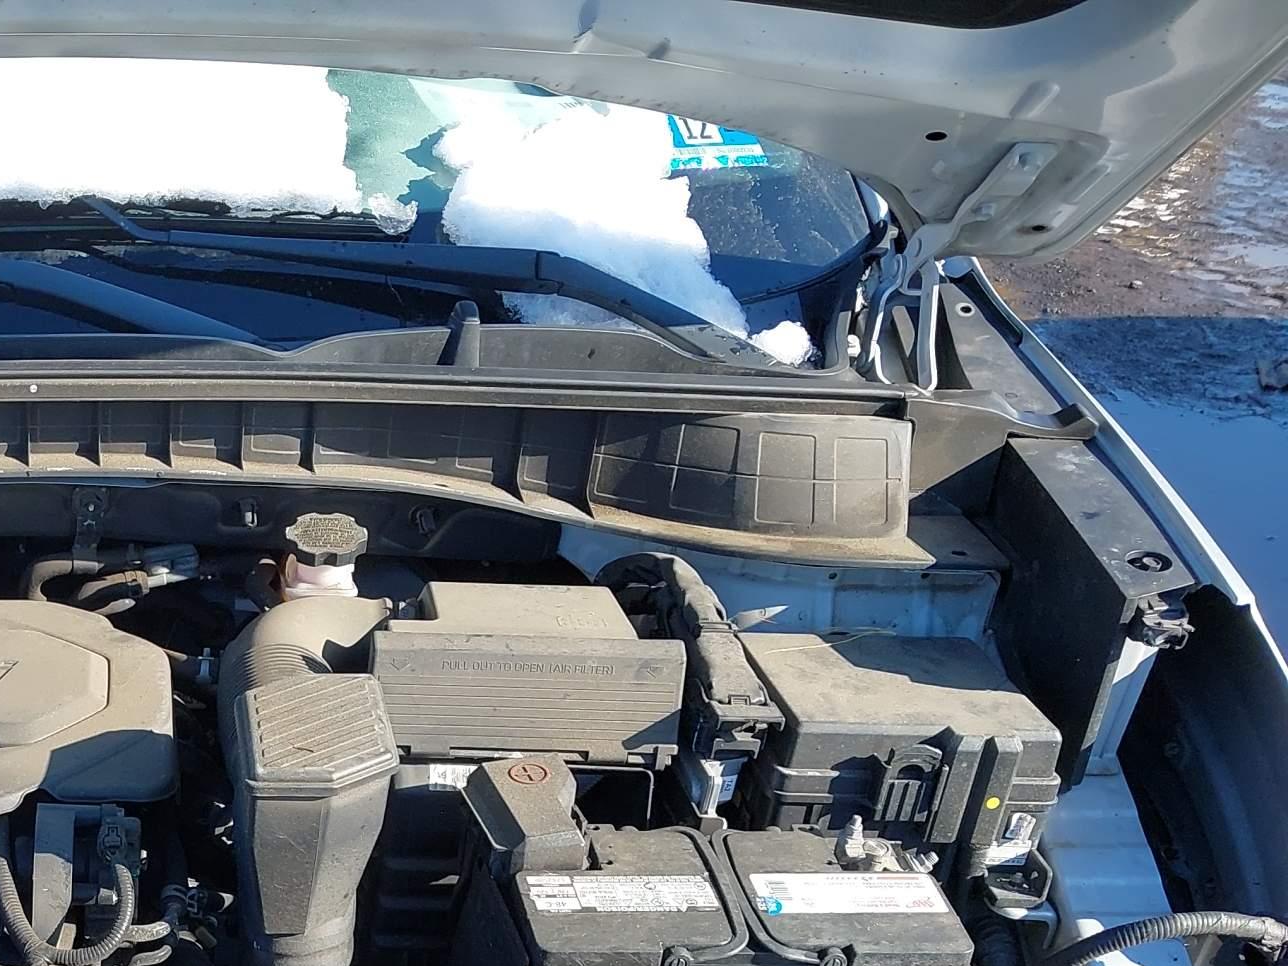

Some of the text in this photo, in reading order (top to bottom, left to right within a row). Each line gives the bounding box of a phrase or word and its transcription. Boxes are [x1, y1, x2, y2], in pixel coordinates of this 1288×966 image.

[441, 660, 469, 671] PULL
[472, 660, 495, 672] OUT
[497, 661, 512, 672] TO
[514, 662, 544, 673] OPEN
